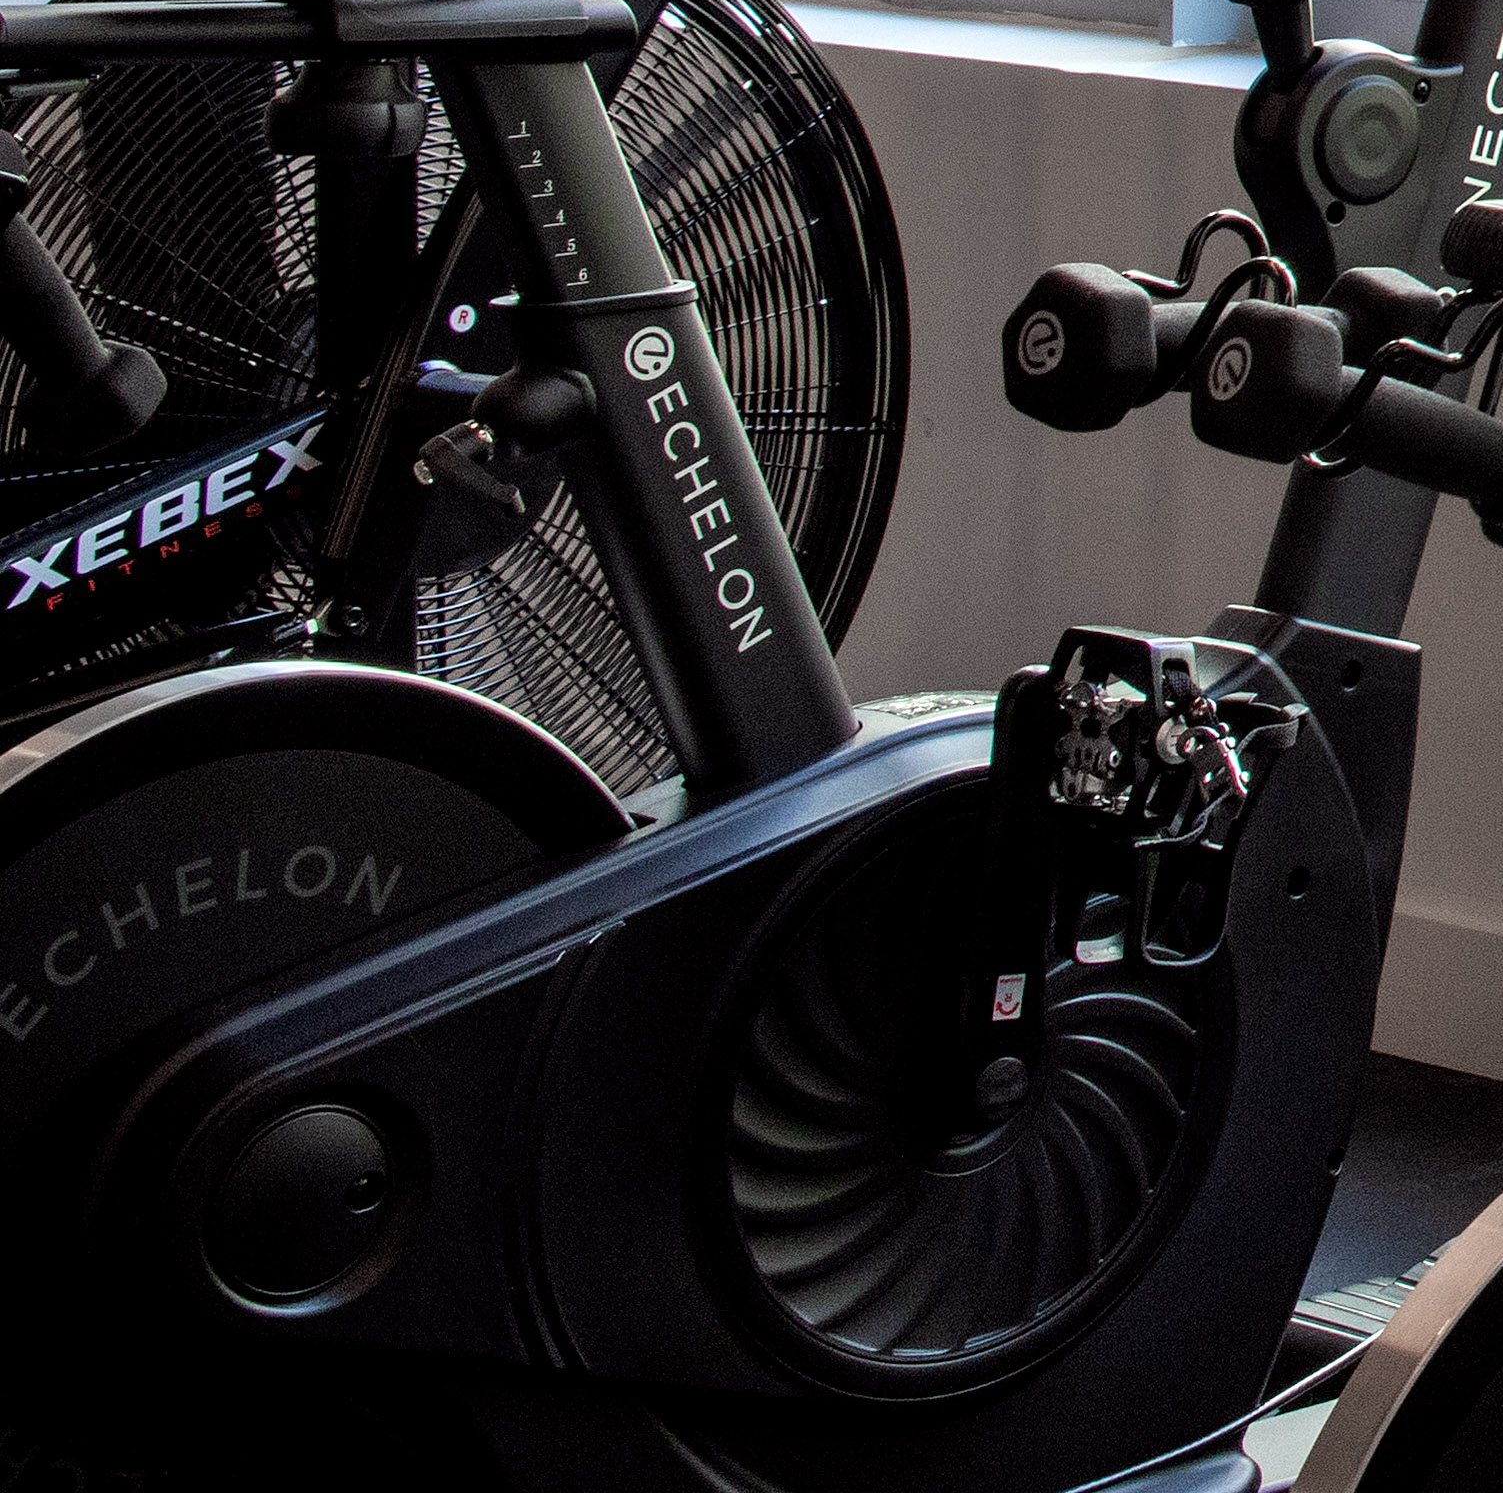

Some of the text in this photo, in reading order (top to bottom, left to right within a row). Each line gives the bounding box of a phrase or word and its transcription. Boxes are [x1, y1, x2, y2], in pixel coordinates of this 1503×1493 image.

[520, 120, 527, 134] 1
[532, 150, 541, 163] 2
[544, 179, 553, 193] 3
[556, 209, 564, 222] 4
[567, 238, 576, 252] 5
[578, 268, 588, 281] 6
[457, 309, 468, 324] R
[5, 422, 325, 611] XEBEX
[646, 381, 773, 653] ECHELON
[0, 845, 402, 1042] ECHELON
